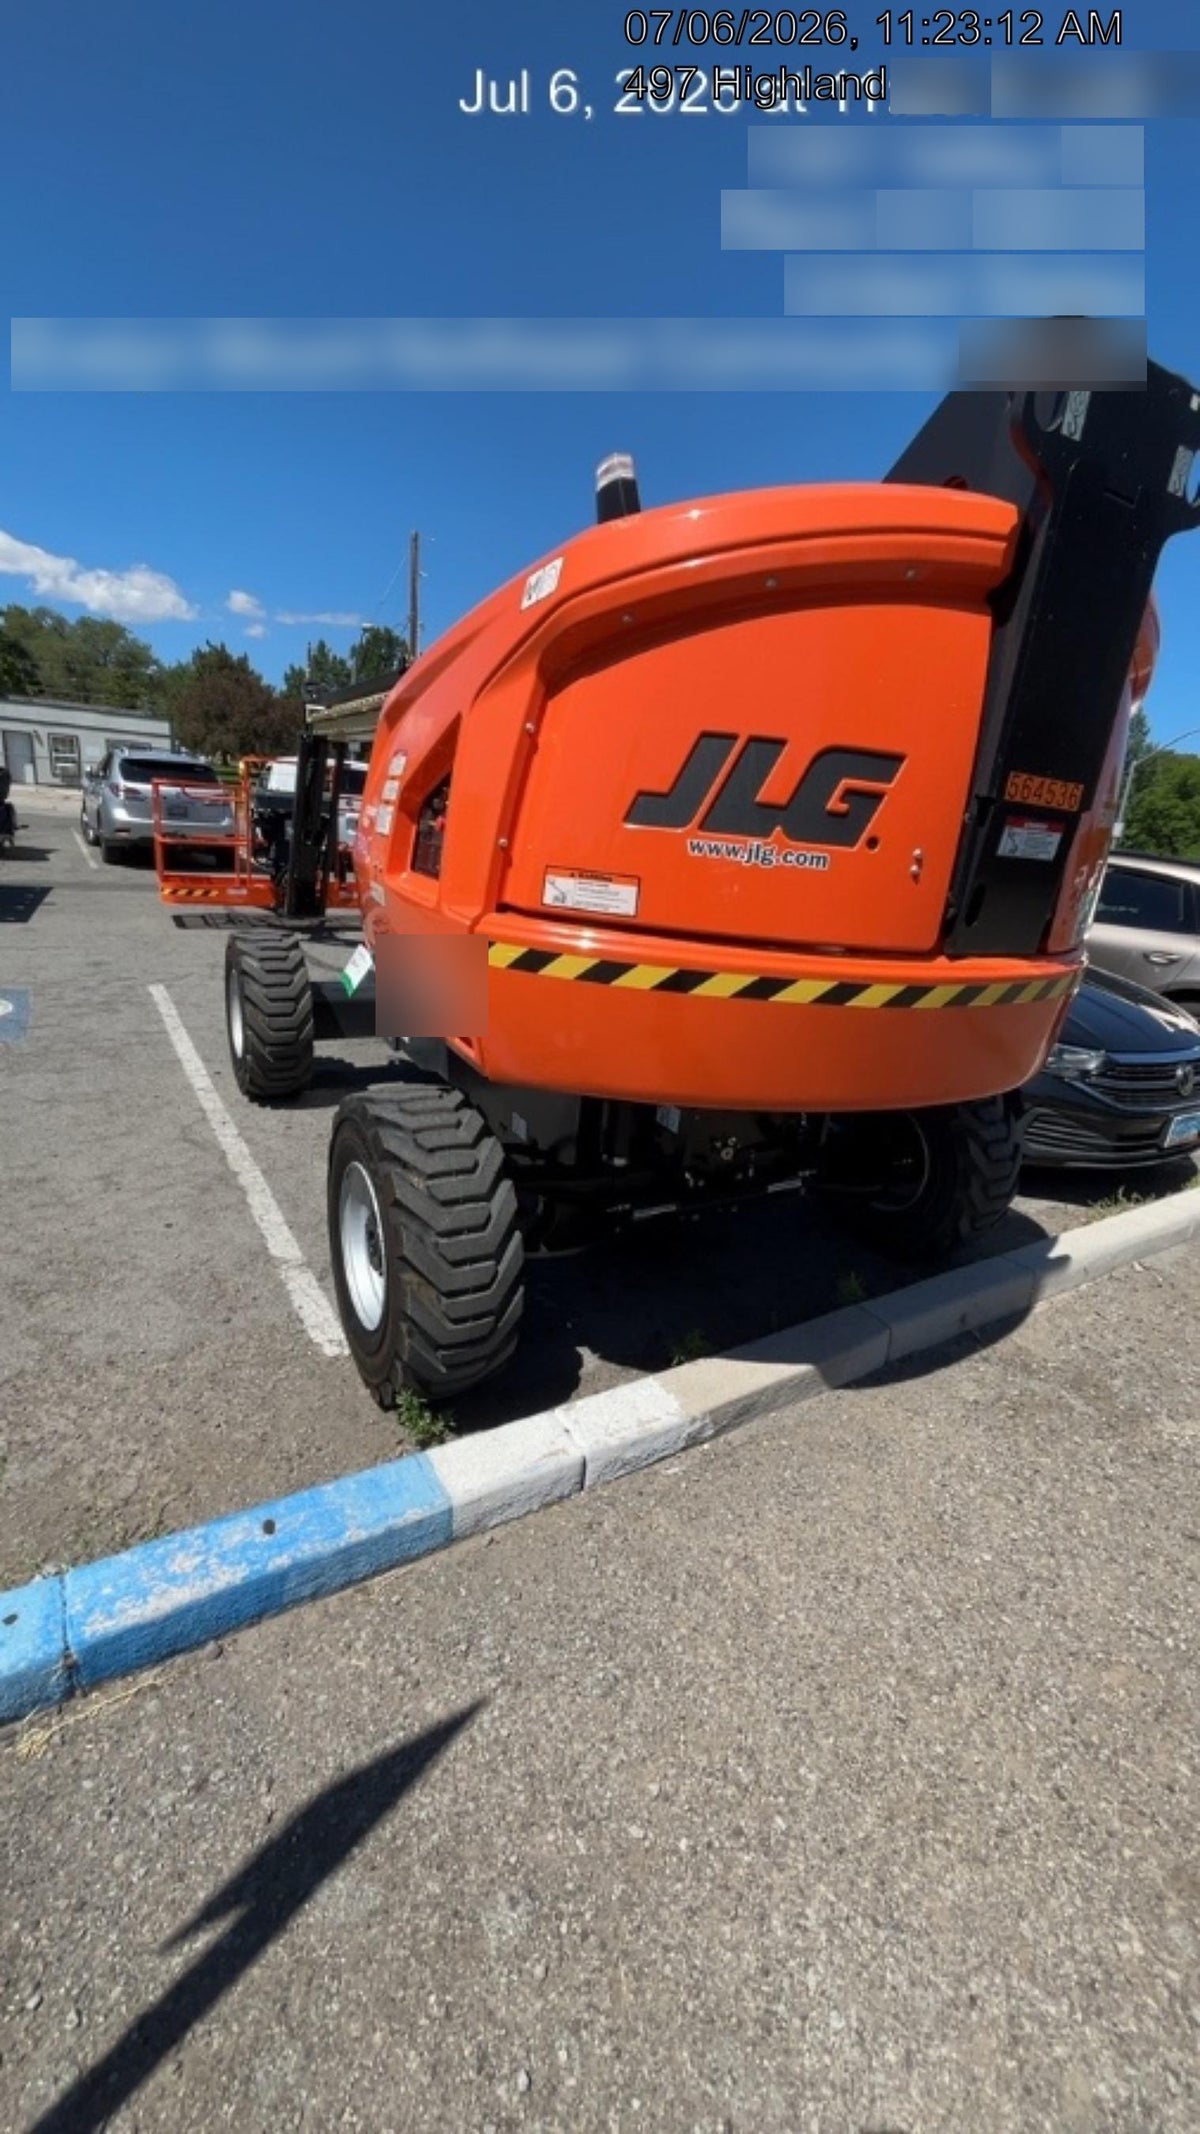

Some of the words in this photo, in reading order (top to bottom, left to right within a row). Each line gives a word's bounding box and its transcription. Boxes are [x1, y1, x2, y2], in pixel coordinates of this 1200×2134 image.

[622, 731, 907, 850] JLG
[1006, 774, 1080, 810] 564536
[687, 838, 830, 869] www.jlg.com
